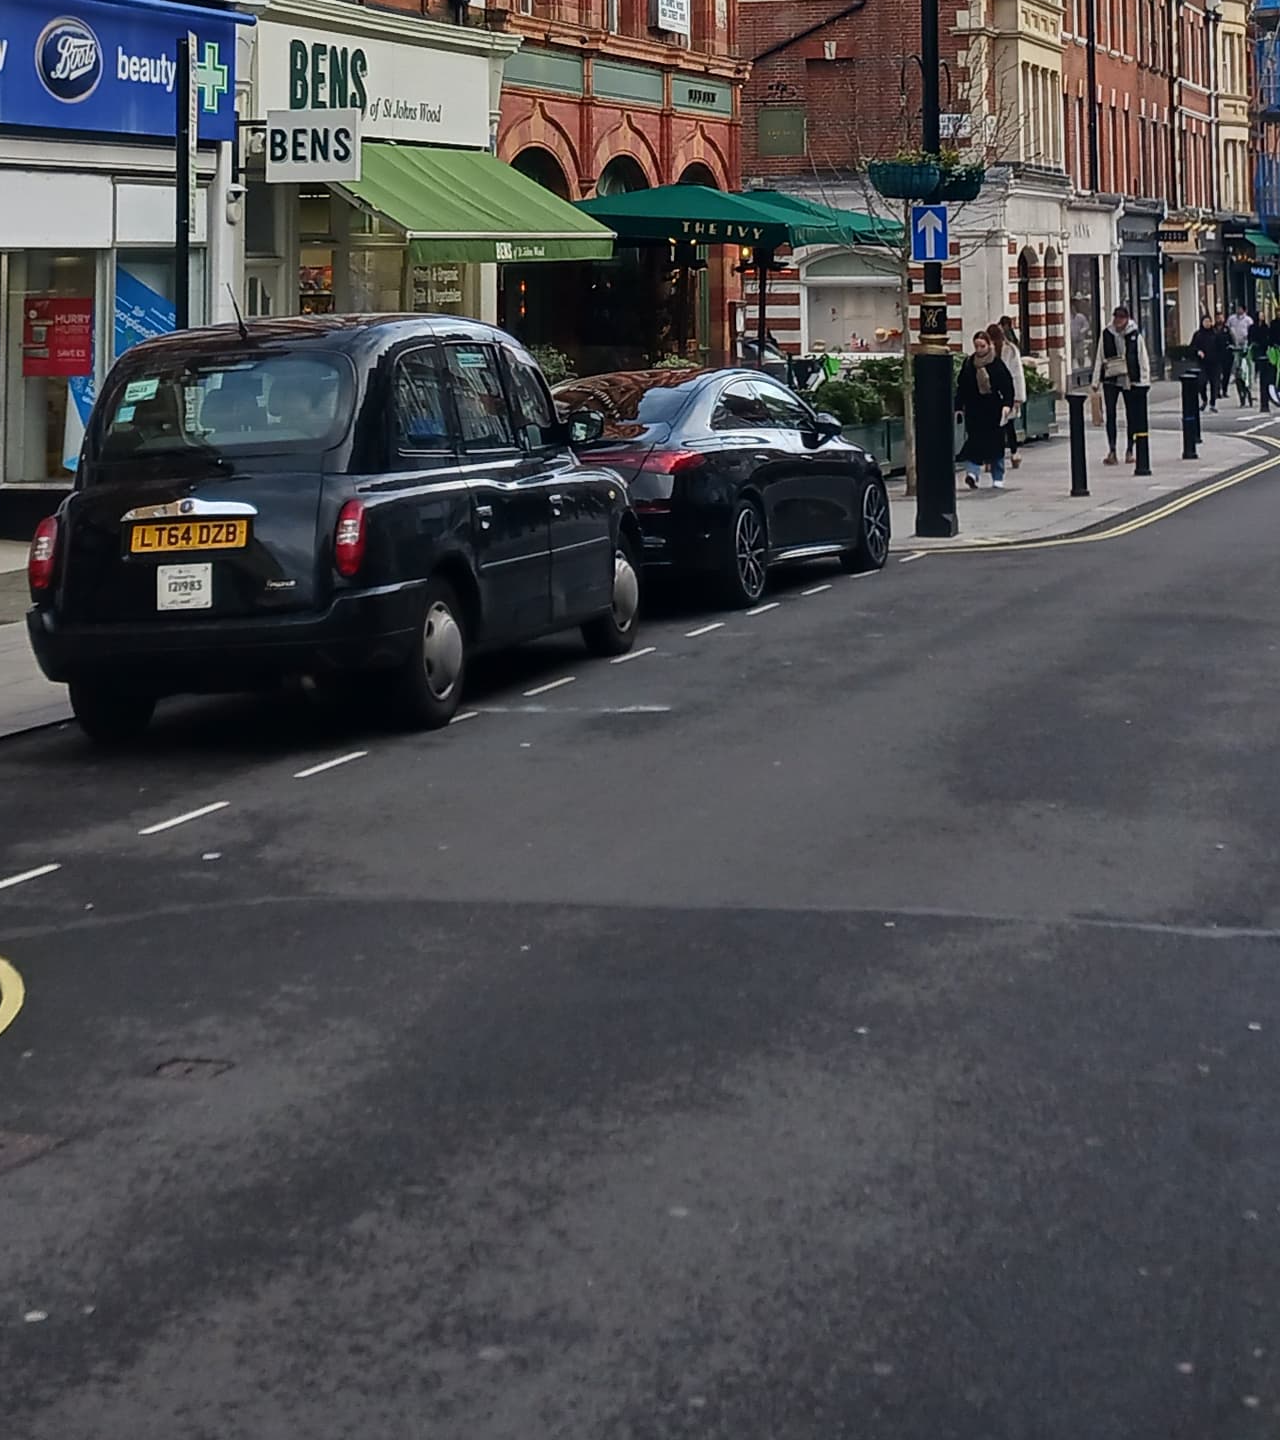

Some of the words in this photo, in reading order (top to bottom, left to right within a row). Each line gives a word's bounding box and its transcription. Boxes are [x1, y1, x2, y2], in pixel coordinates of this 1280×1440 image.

[50, 35, 96, 80] Boots
[117, 45, 176, 92] beauty
[289, 39, 367, 121] BENS
[369, 97, 381, 121] of
[393, 99, 418, 120] Johns
[420, 102, 442, 122] Wood
[270, 127, 352, 163] BENS
[681, 221, 718, 235] THE
[726, 224, 764, 240] IVY
[55, 314, 91, 325] HURRY
[140, 525, 192, 548] LT64
[198, 523, 237, 544] DZB
